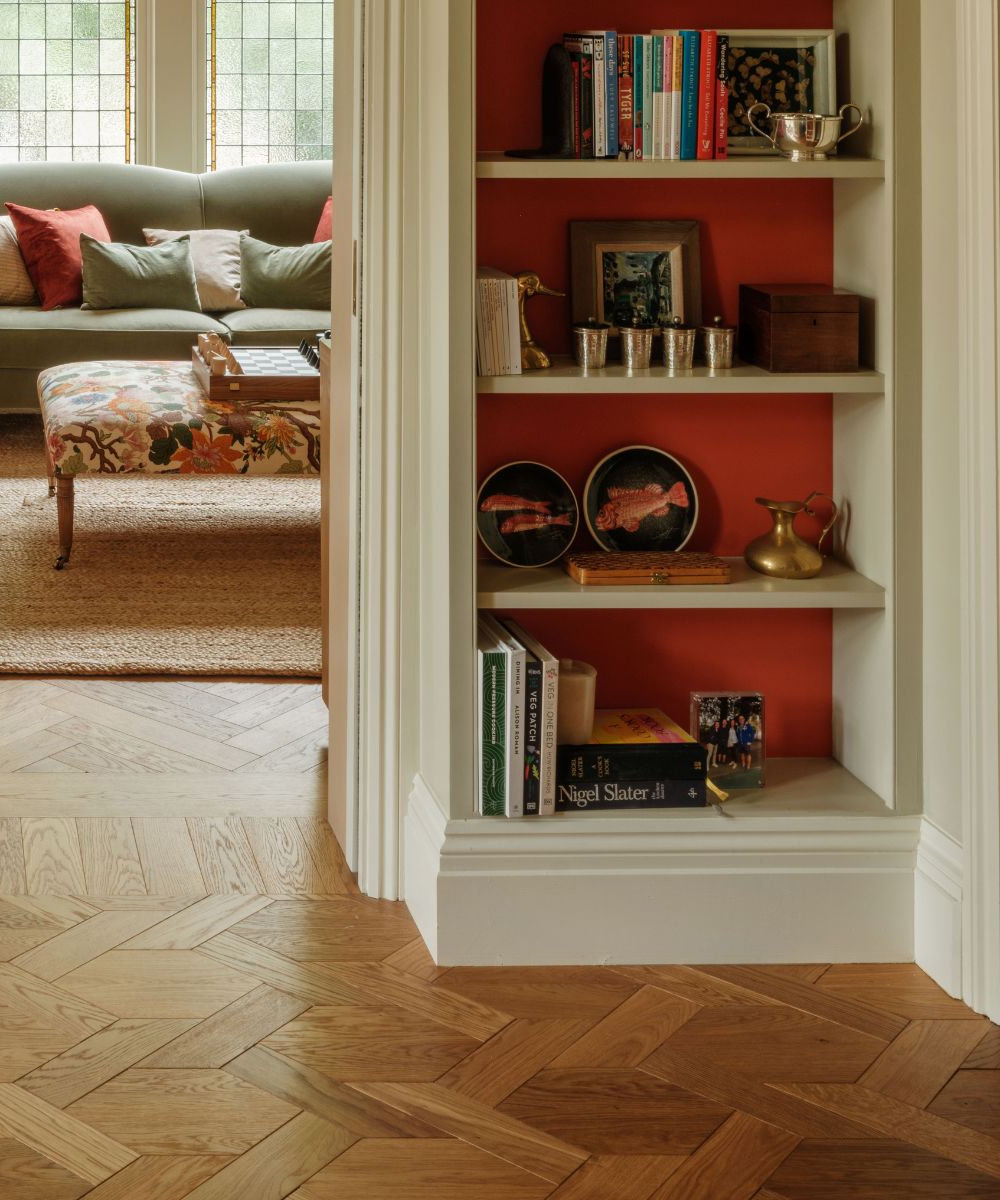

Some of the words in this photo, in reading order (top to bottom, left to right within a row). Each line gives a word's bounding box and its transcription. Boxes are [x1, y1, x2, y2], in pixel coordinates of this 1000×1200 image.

[607, 59, 615, 76] days
[621, 88, 631, 120] TYGER
[559, 784, 599, 807] Nigel
[604, 784, 648, 801] Slater
